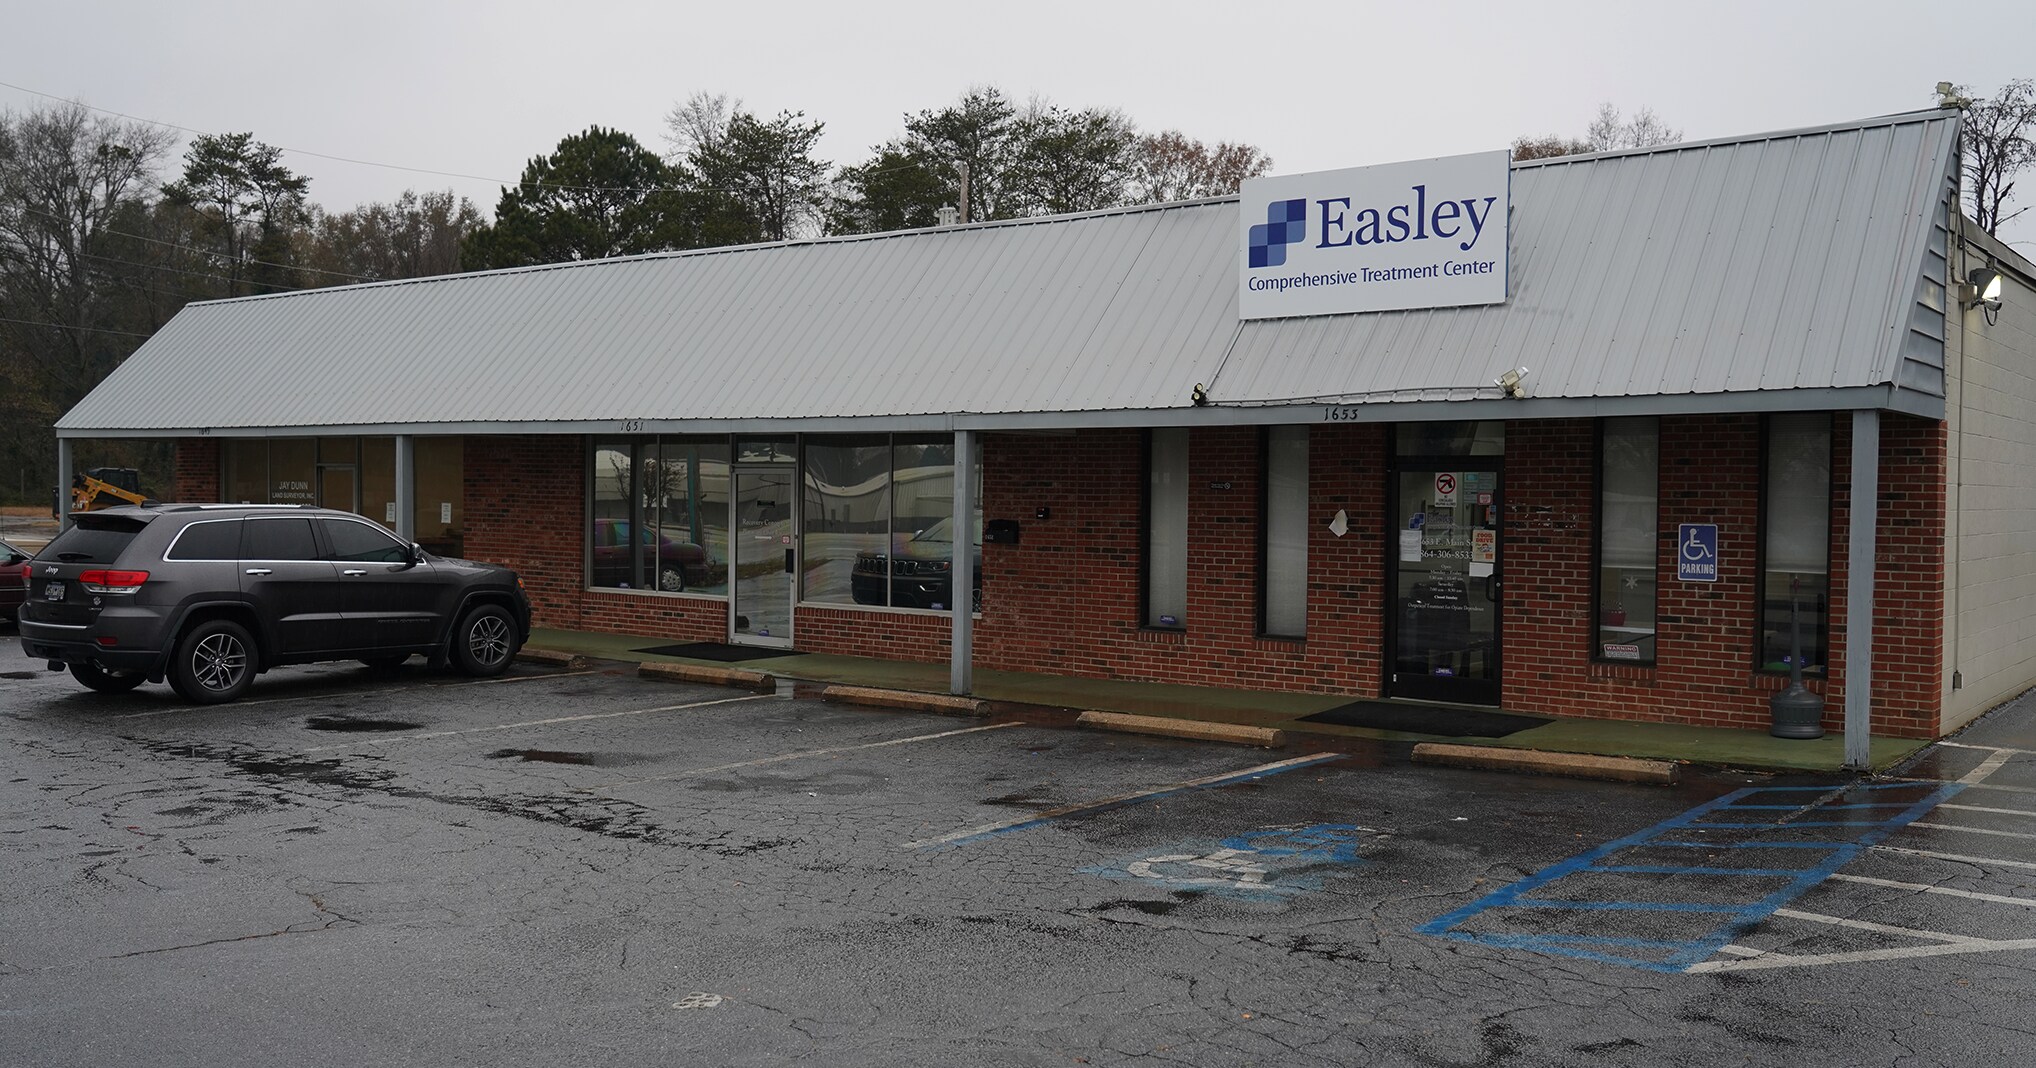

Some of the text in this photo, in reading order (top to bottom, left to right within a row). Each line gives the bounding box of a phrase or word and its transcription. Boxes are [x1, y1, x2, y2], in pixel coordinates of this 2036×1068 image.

[1315, 184, 1497, 251] Easley
[1248, 259, 1496, 293] Comprehensive Treatment Center
[1324, 407, 1359, 421] 1653
[620, 421, 644, 432] 1651
[278, 481, 309, 490] JAY DUNN
[1445, 538, 1464, 547] Main
[1421, 550, 1473, 559] 864-306-8533
[45, 565, 59, 575] Jeep
[1681, 562, 1714, 575] PARKING
